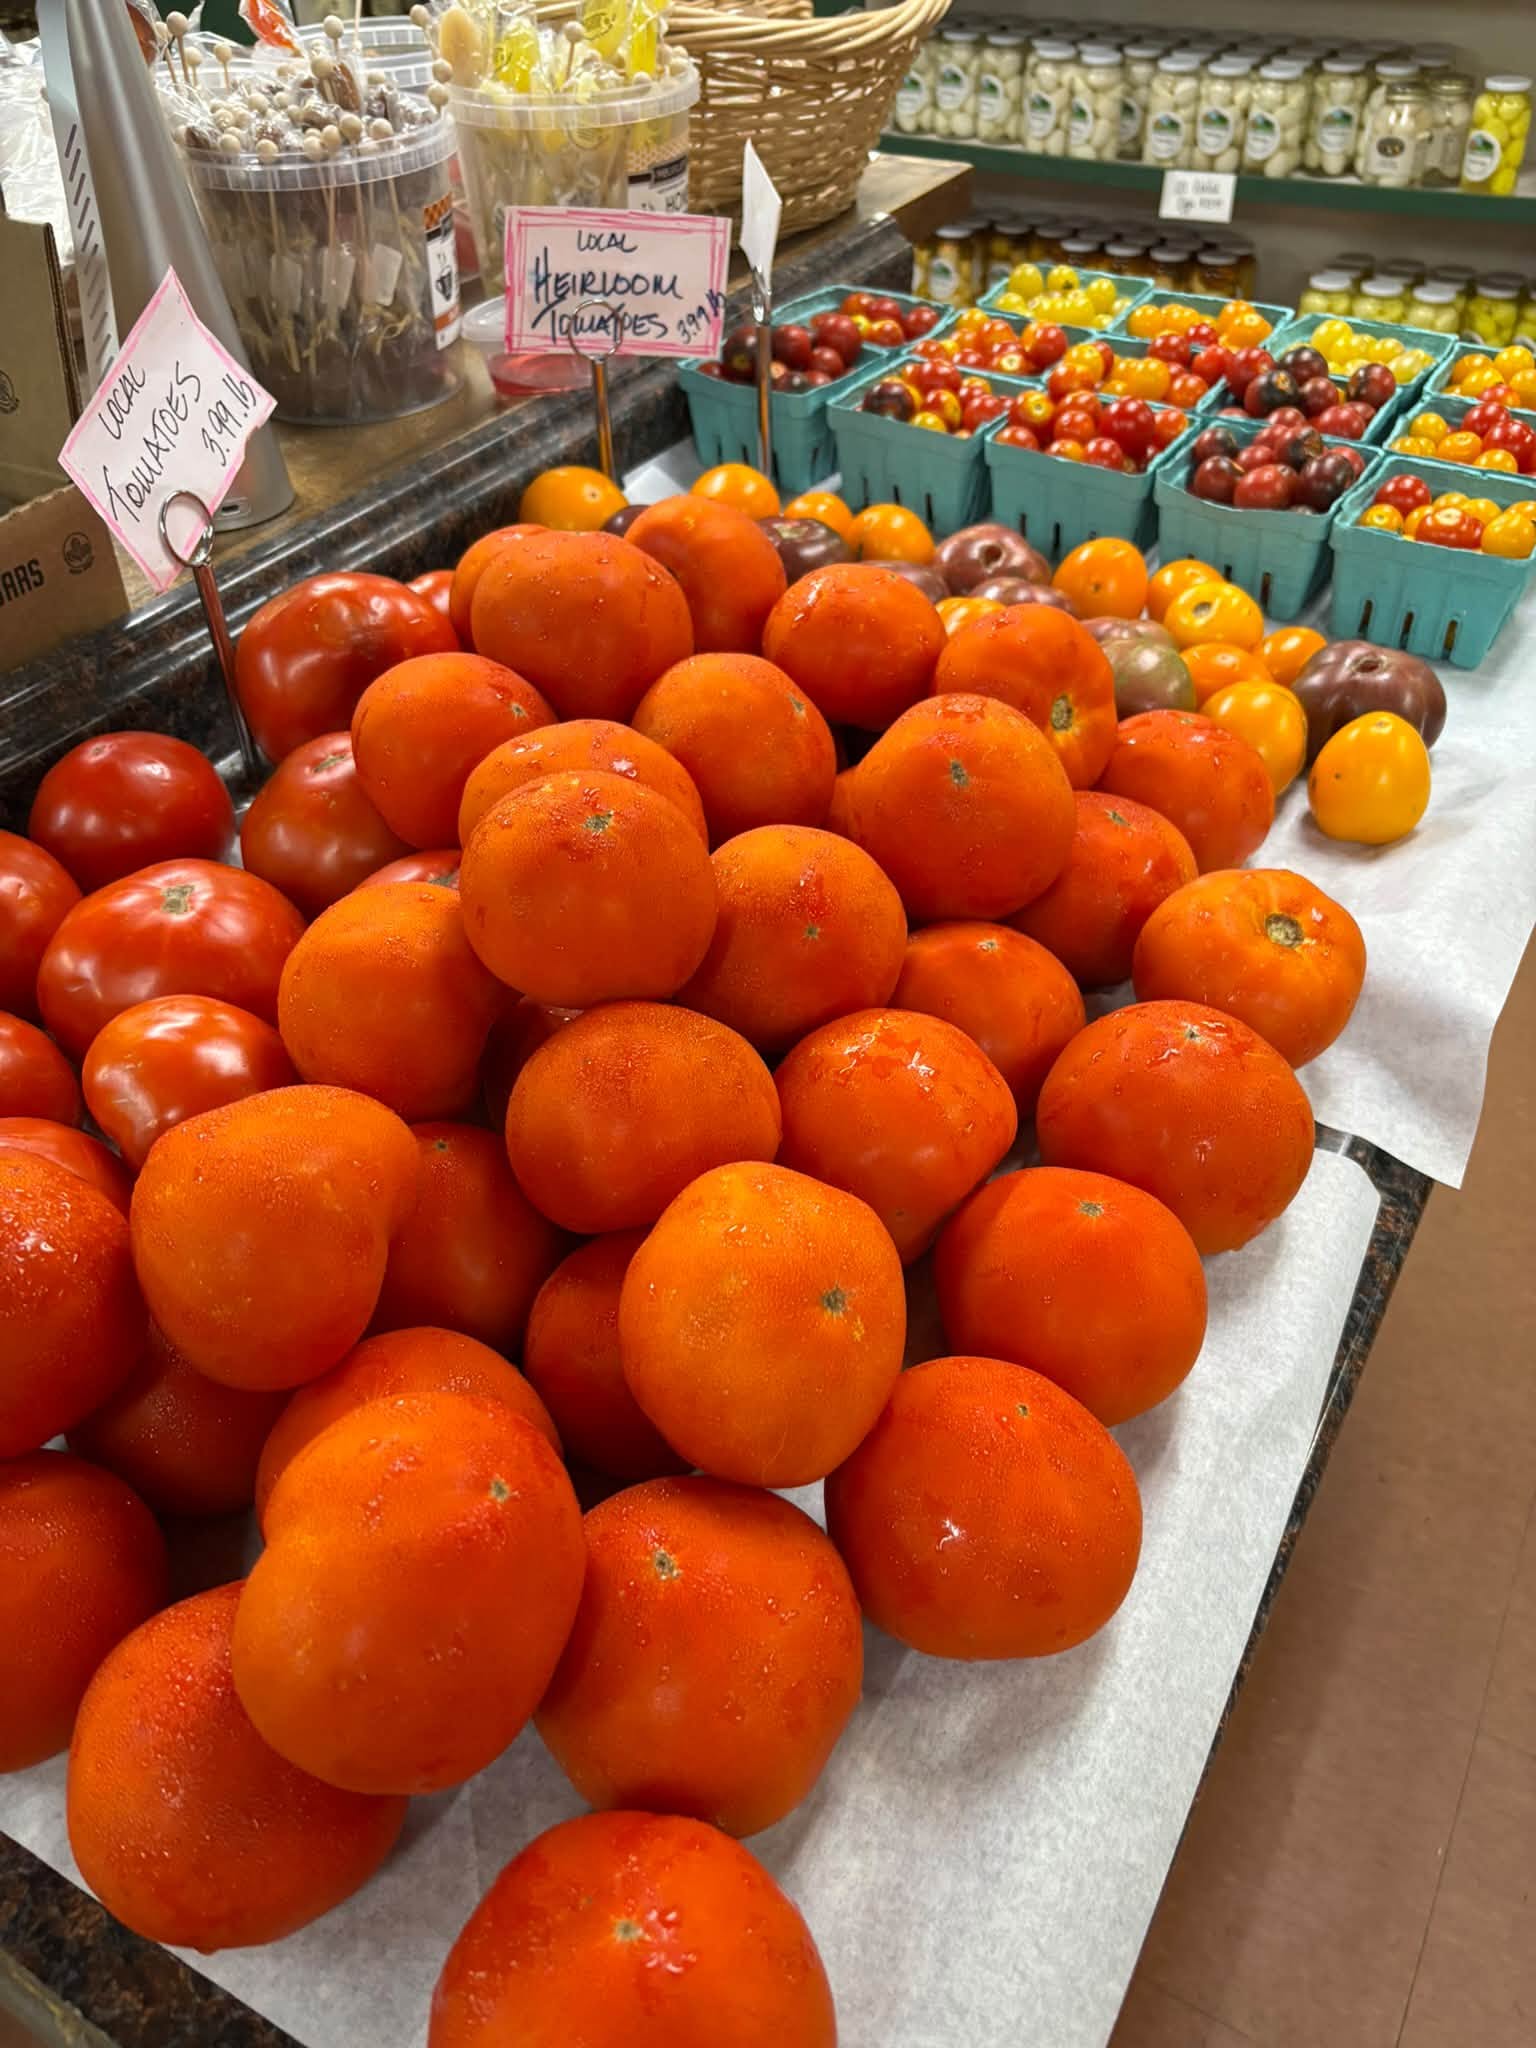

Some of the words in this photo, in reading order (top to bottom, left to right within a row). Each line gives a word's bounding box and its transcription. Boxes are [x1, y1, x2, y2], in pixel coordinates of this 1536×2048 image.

[576, 229, 638, 253] LOCAL
[533, 246, 684, 305] HEIRLOOM
[530, 298, 668, 345] TOMATOES
[97, 363, 146, 440] LOCAL
[102, 359, 202, 523] TOMATOES
